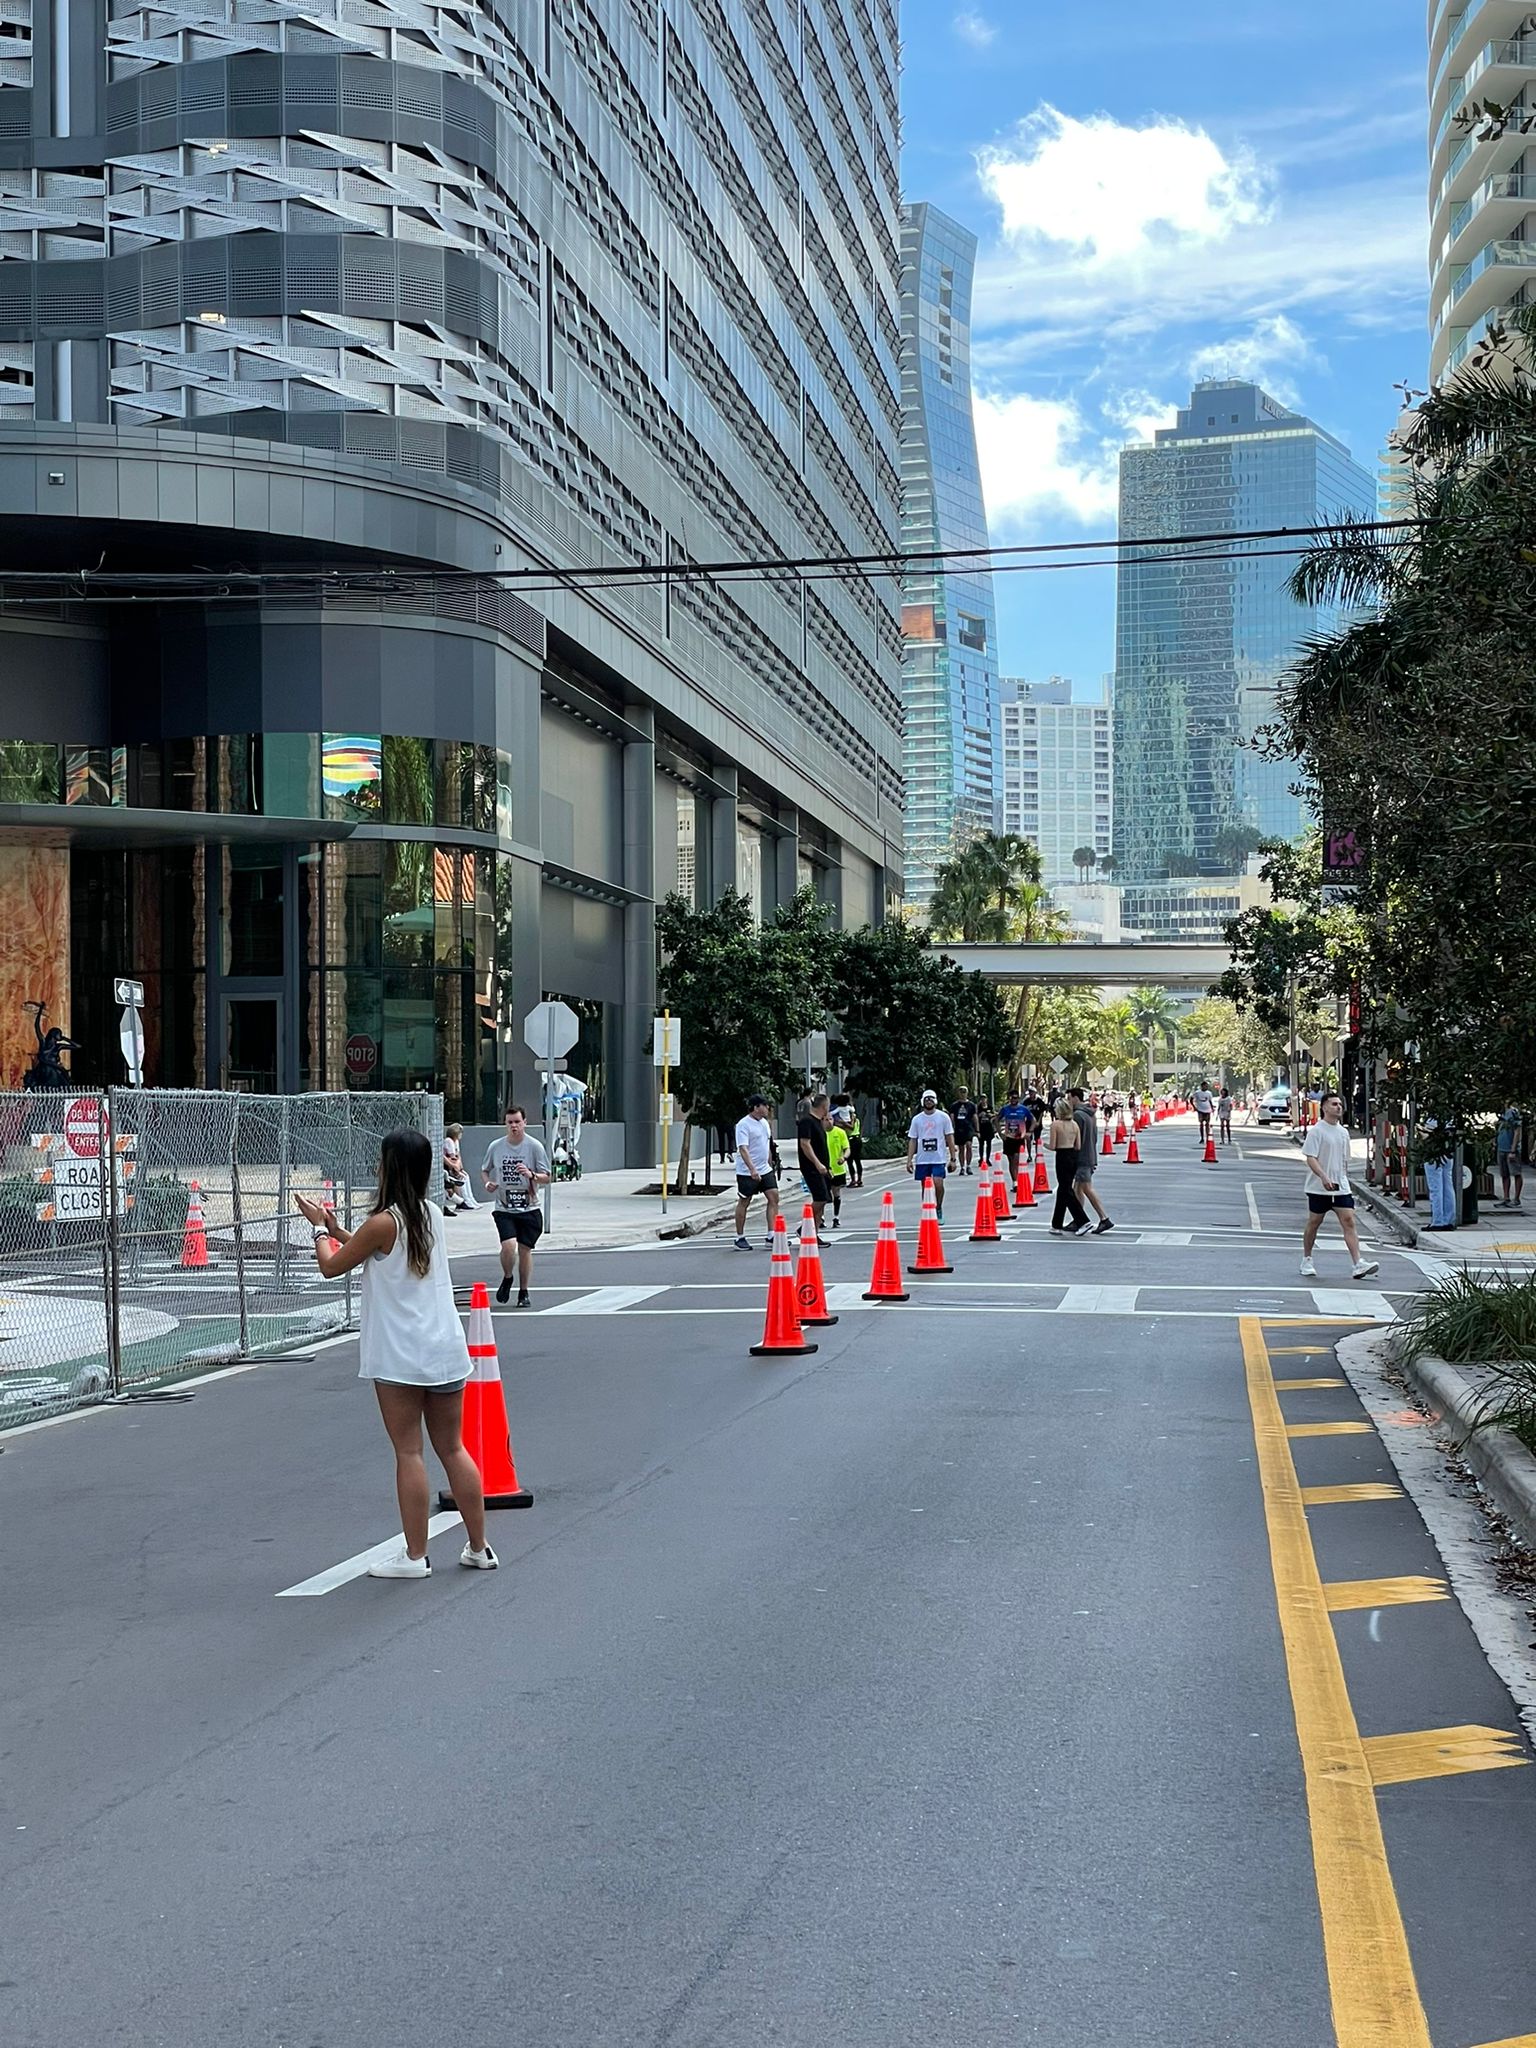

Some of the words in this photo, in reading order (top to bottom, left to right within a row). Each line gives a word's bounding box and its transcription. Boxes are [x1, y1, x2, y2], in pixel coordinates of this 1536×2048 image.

[71, 1109, 82, 1120] DO
[87, 1109, 102, 1120] NO
[75, 1136, 100, 1147] ENTER
[61, 1191, 111, 1210] CLOSE
